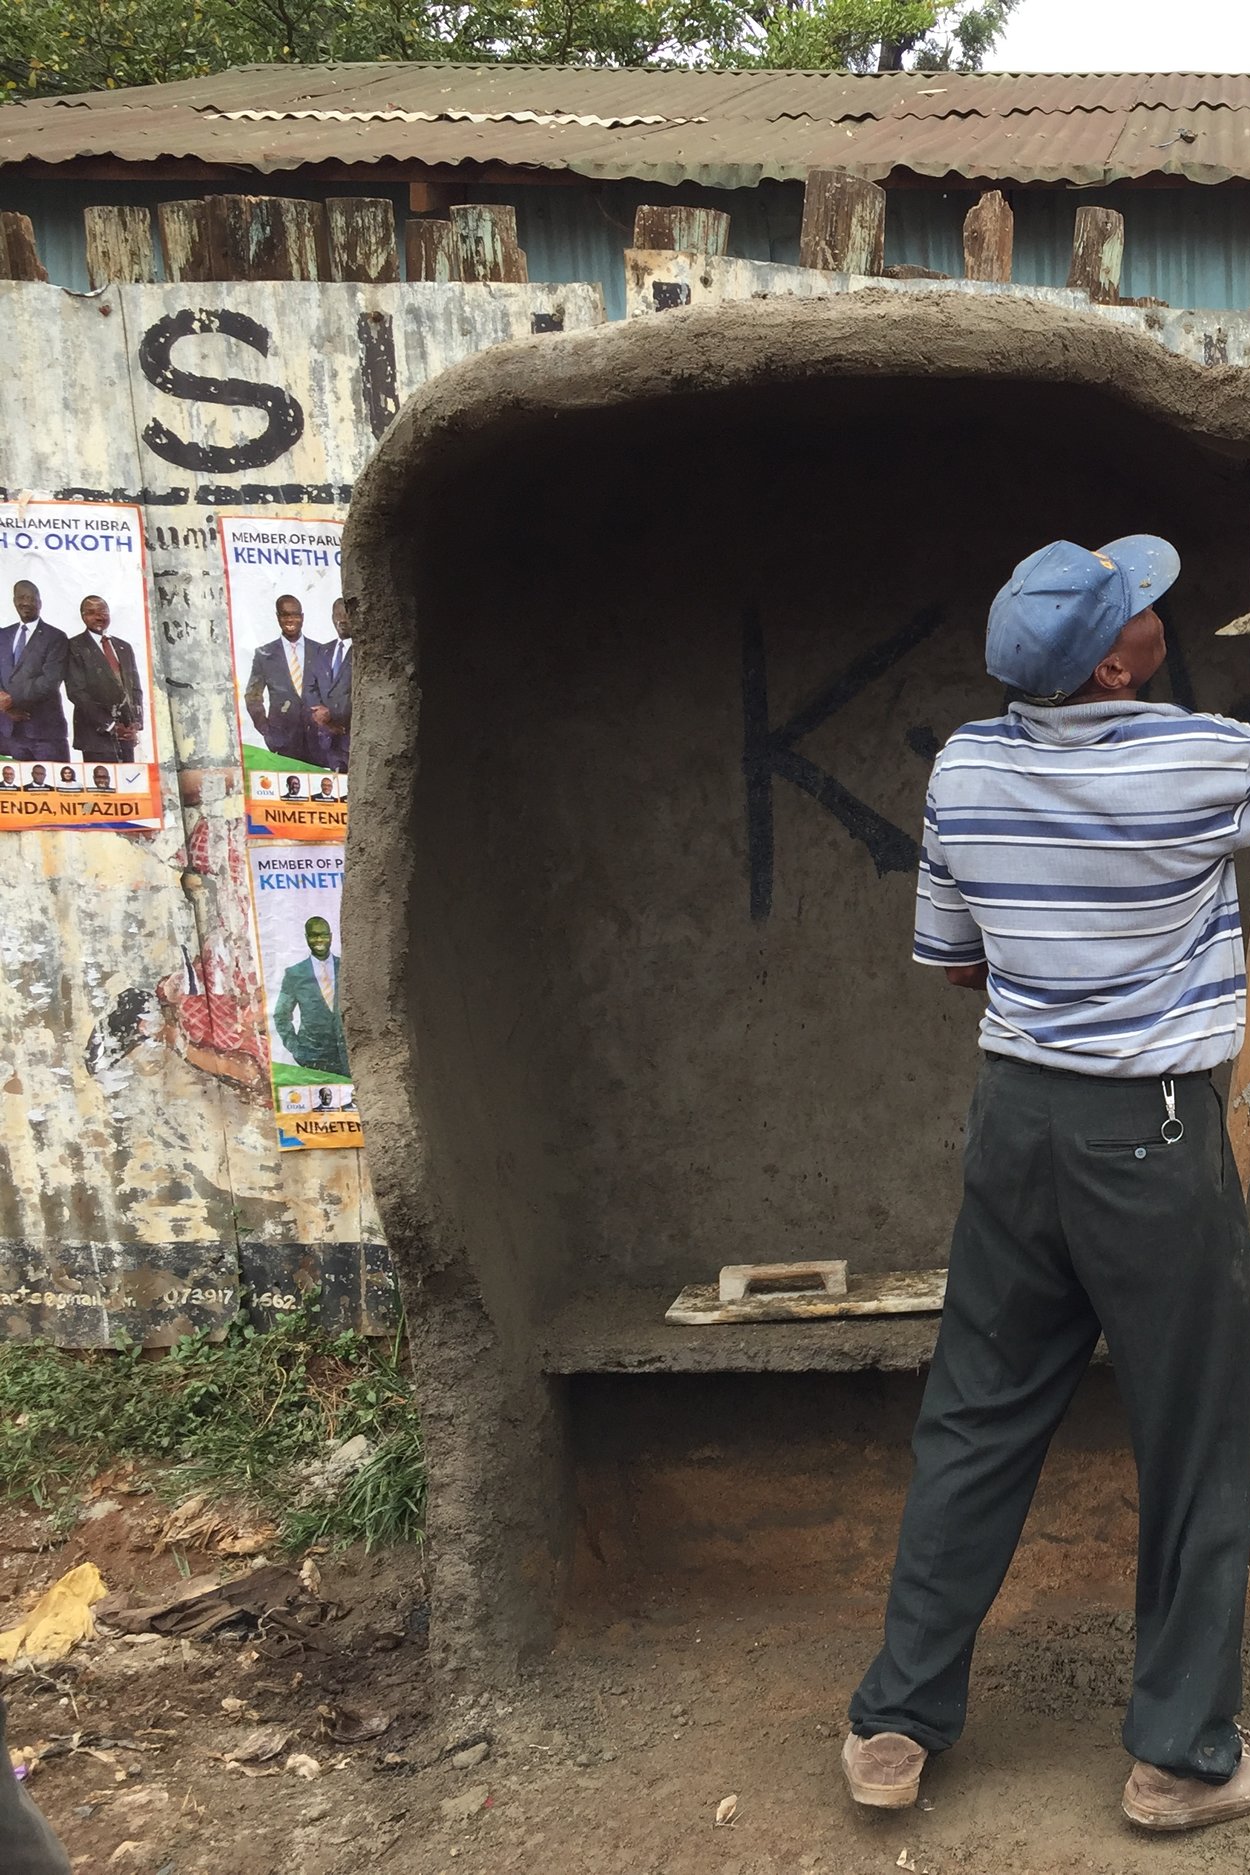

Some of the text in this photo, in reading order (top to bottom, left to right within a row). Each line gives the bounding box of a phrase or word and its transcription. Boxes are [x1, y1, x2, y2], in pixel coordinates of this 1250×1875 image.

[84, 519, 131, 532] KIBRA
[15, 532, 39, 549] O.
[44, 533, 133, 553] OKOTH
[231, 531, 287, 544] MEMBER
[288, 534, 306, 545] OF
[233, 546, 329, 567] KENNETH
[258, 860, 314, 870] MEMBER
[316, 859, 333, 869] OF
